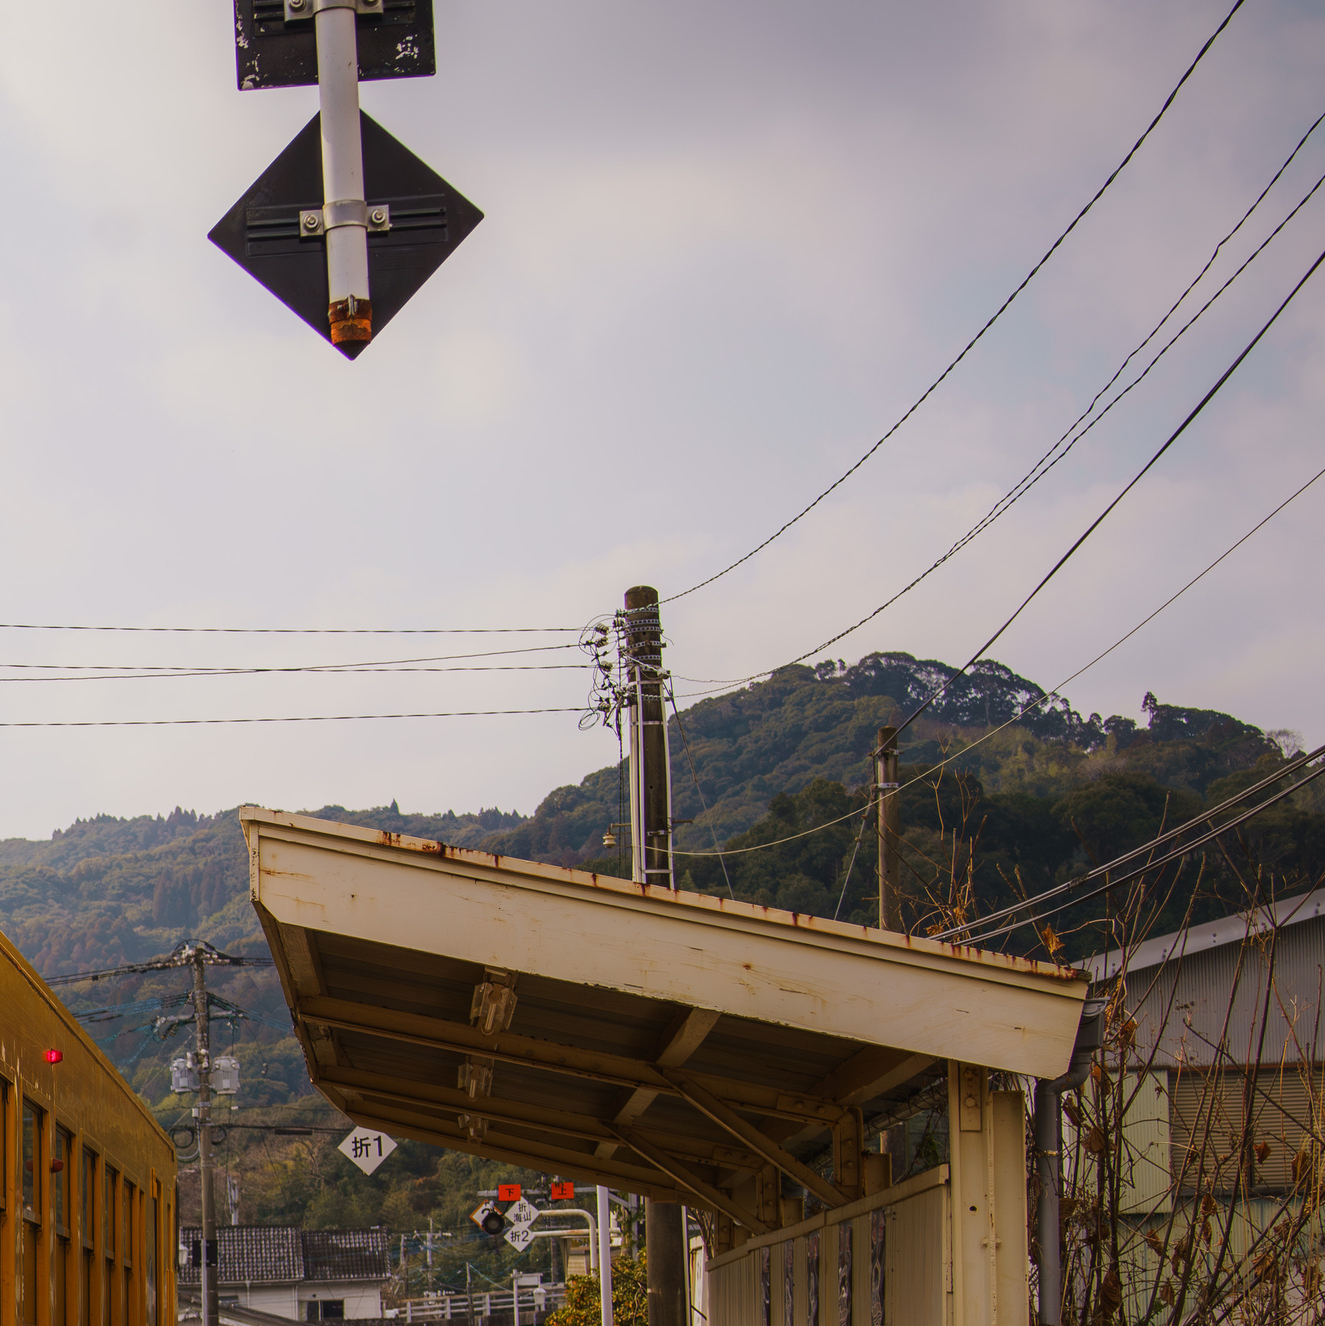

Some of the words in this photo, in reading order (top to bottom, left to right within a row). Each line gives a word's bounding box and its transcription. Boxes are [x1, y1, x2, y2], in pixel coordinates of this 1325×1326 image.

[352, 1135, 383, 1158] 折1
[505, 1188, 515, 1197] 下
[518, 1202, 527, 1213] 折
[510, 1230, 529, 1242] 折2
